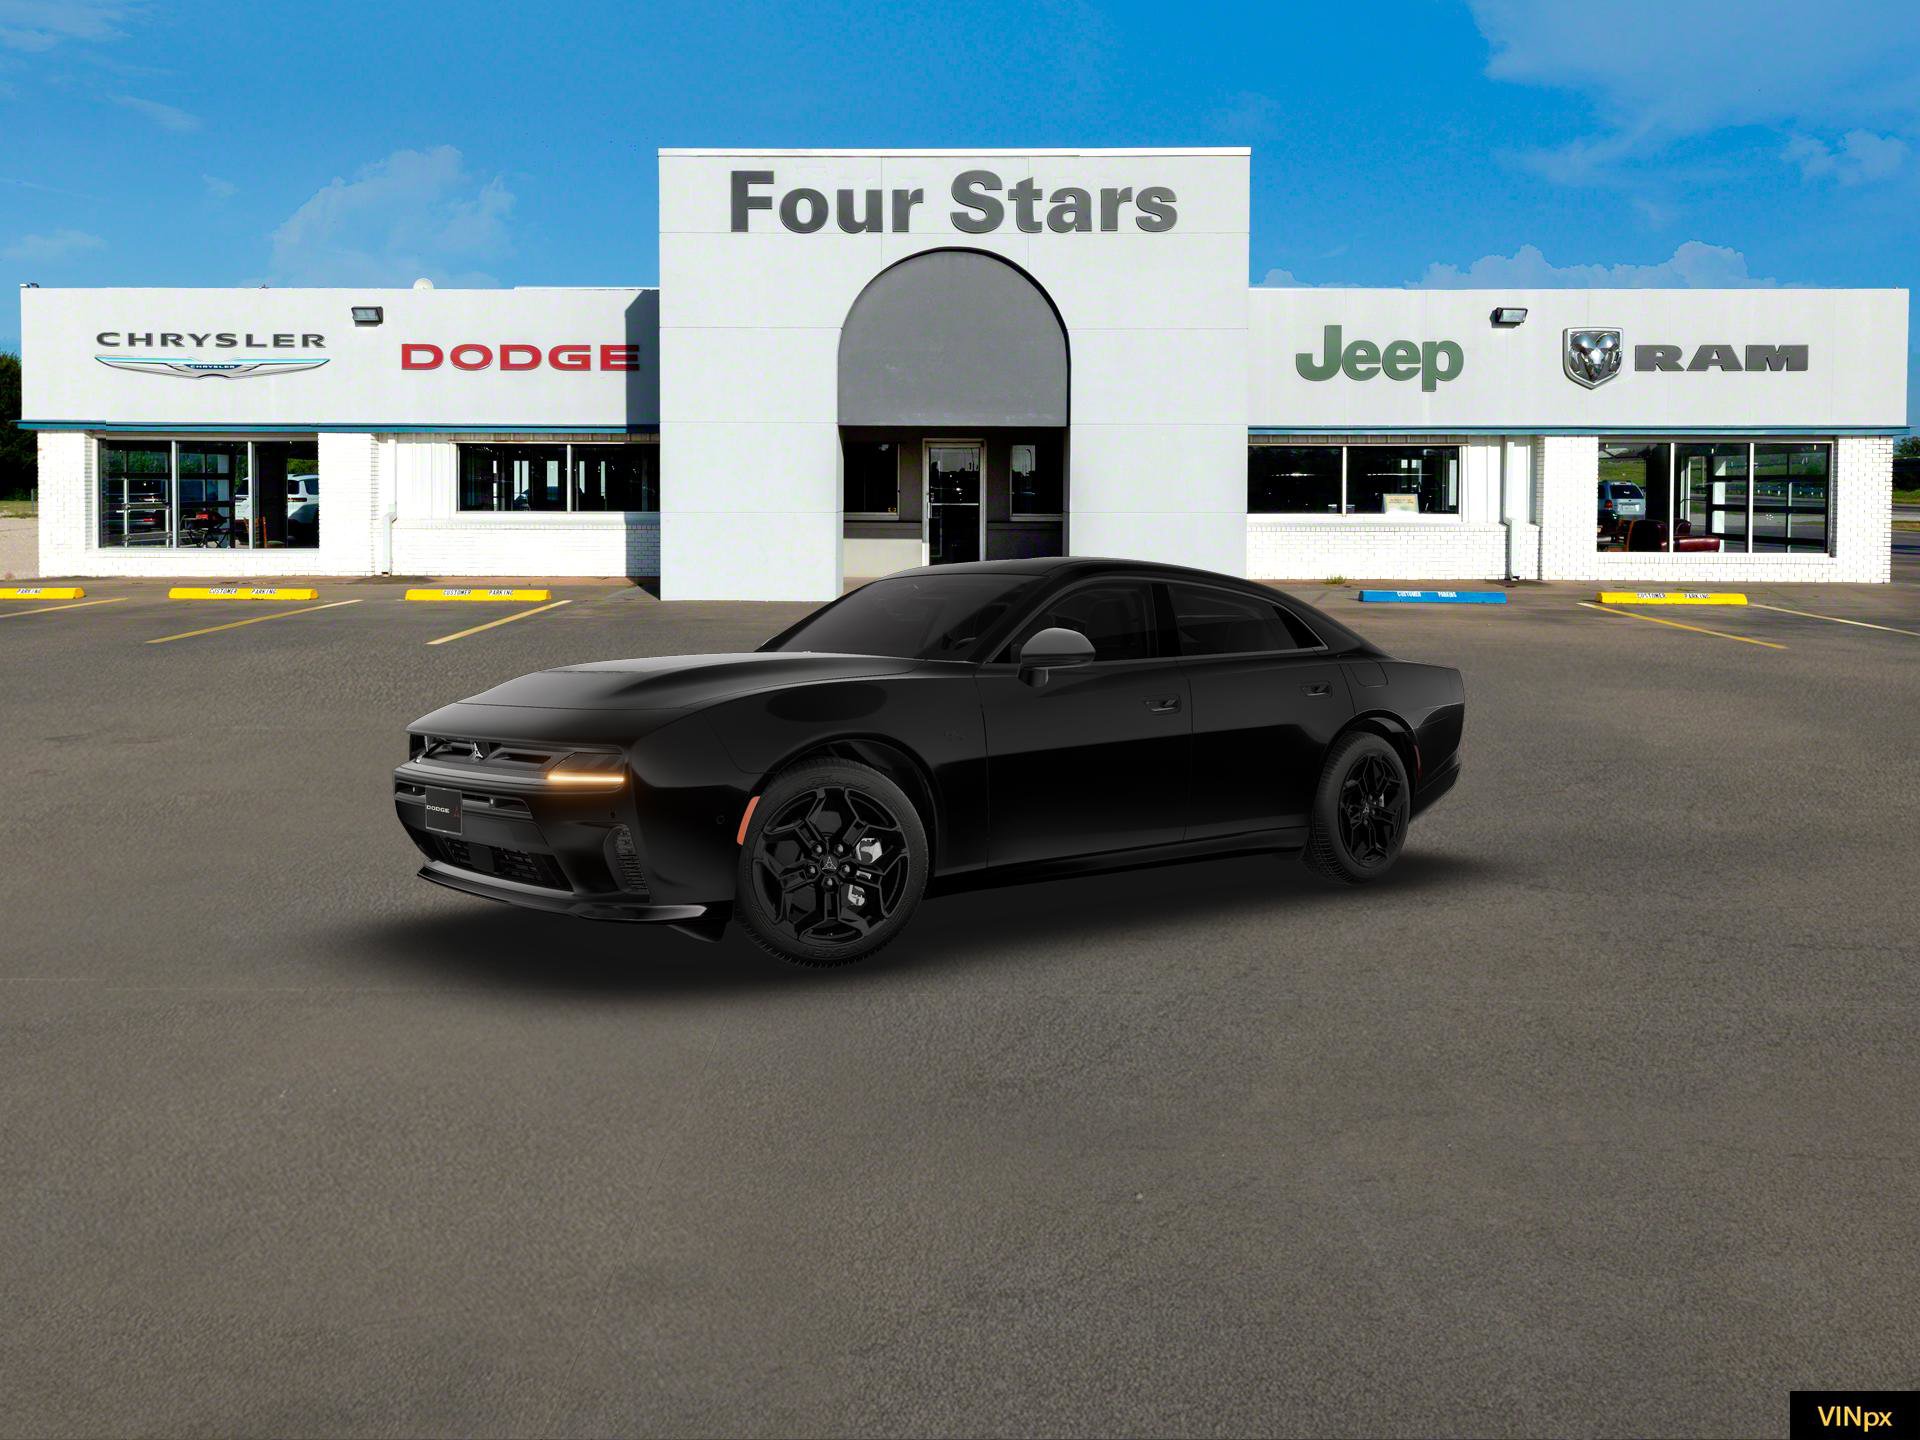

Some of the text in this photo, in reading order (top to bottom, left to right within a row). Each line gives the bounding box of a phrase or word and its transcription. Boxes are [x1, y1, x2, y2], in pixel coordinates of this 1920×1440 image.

[731, 169, 1178, 234] Four Stars
[96, 331, 327, 349] CHRYSLER
[401, 343, 641, 372] DODGE
[1295, 325, 1464, 392] Jeep
[1634, 344, 1809, 372] RAM
[426, 804, 450, 814] DODGE
